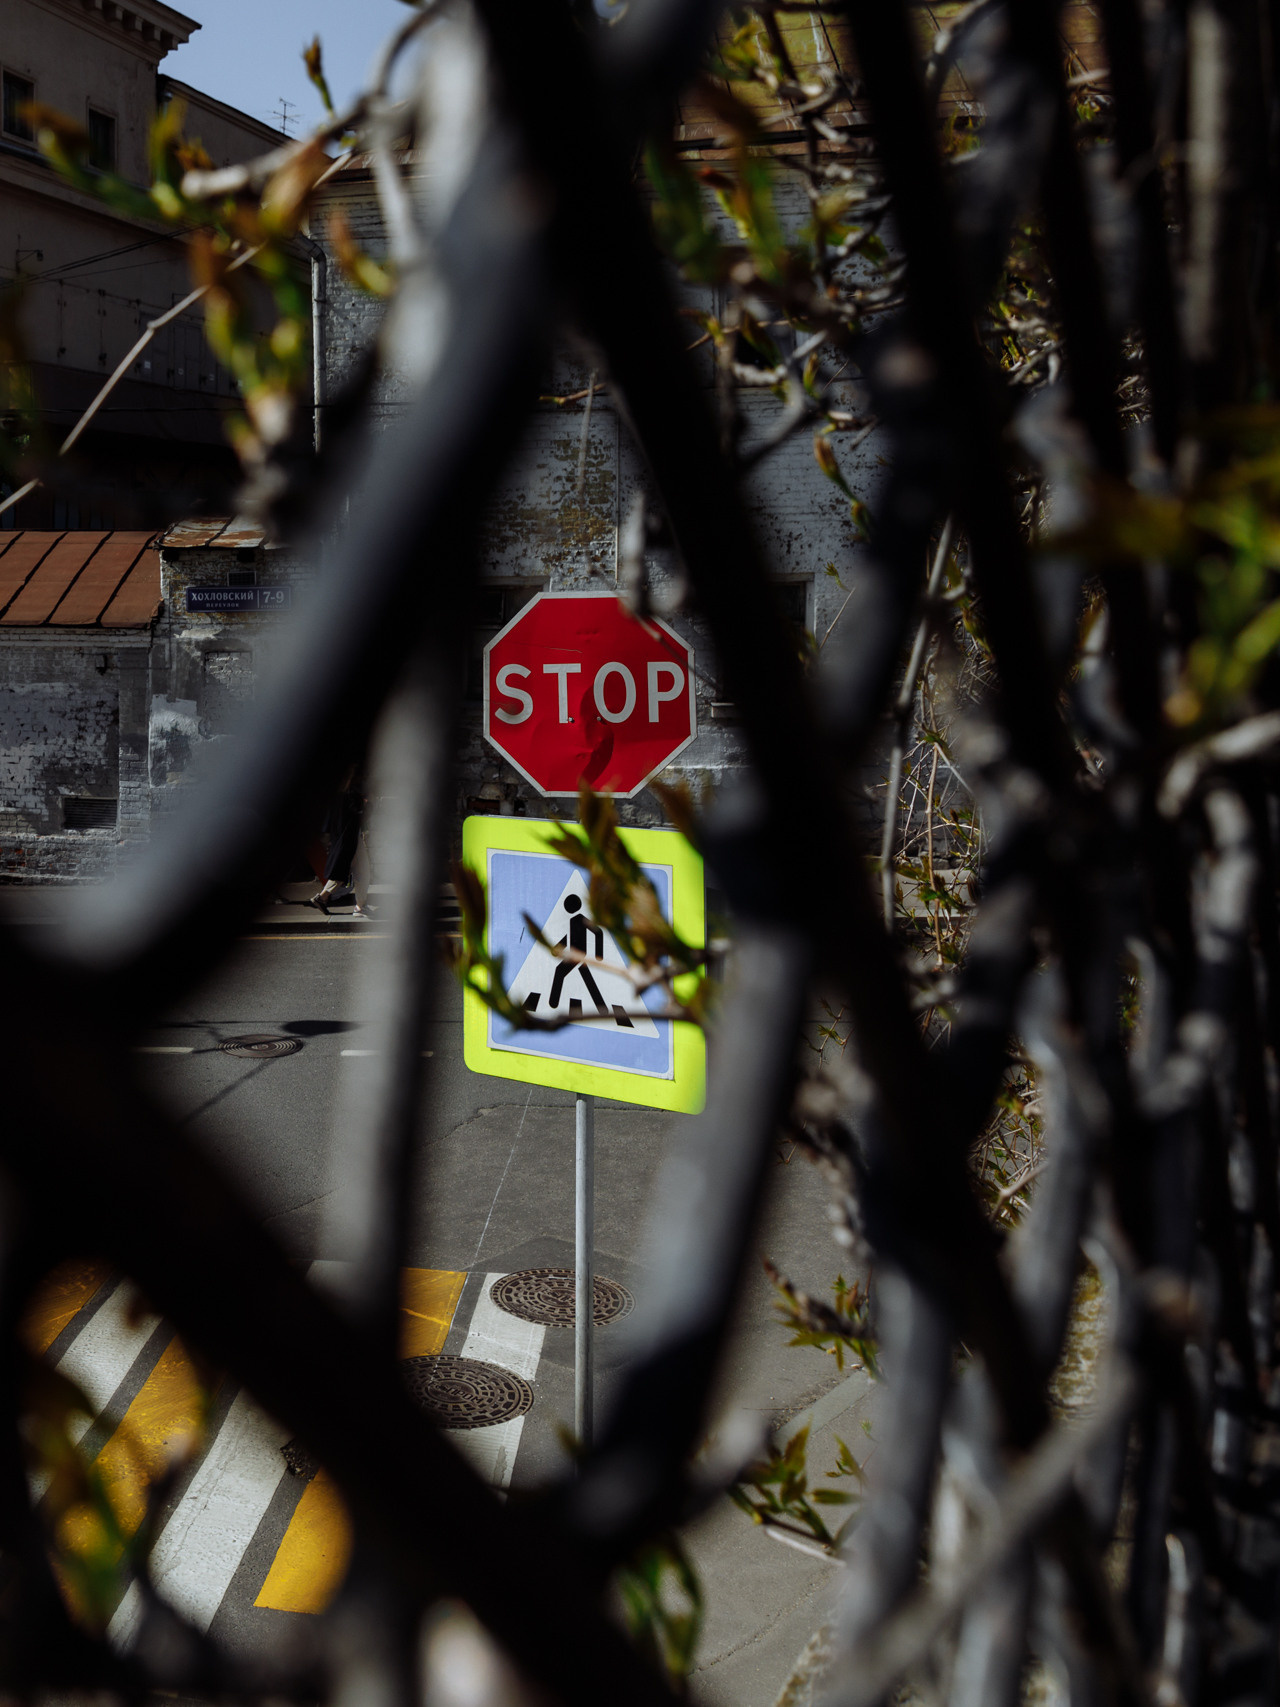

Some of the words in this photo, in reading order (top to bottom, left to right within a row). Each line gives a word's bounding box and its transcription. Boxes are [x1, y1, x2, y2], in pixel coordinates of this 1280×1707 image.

[191, 590, 254, 601] ХОХЛОВСКИЙ
[263, 590, 284, 603] 7-9
[494, 661, 685, 725] STOP
